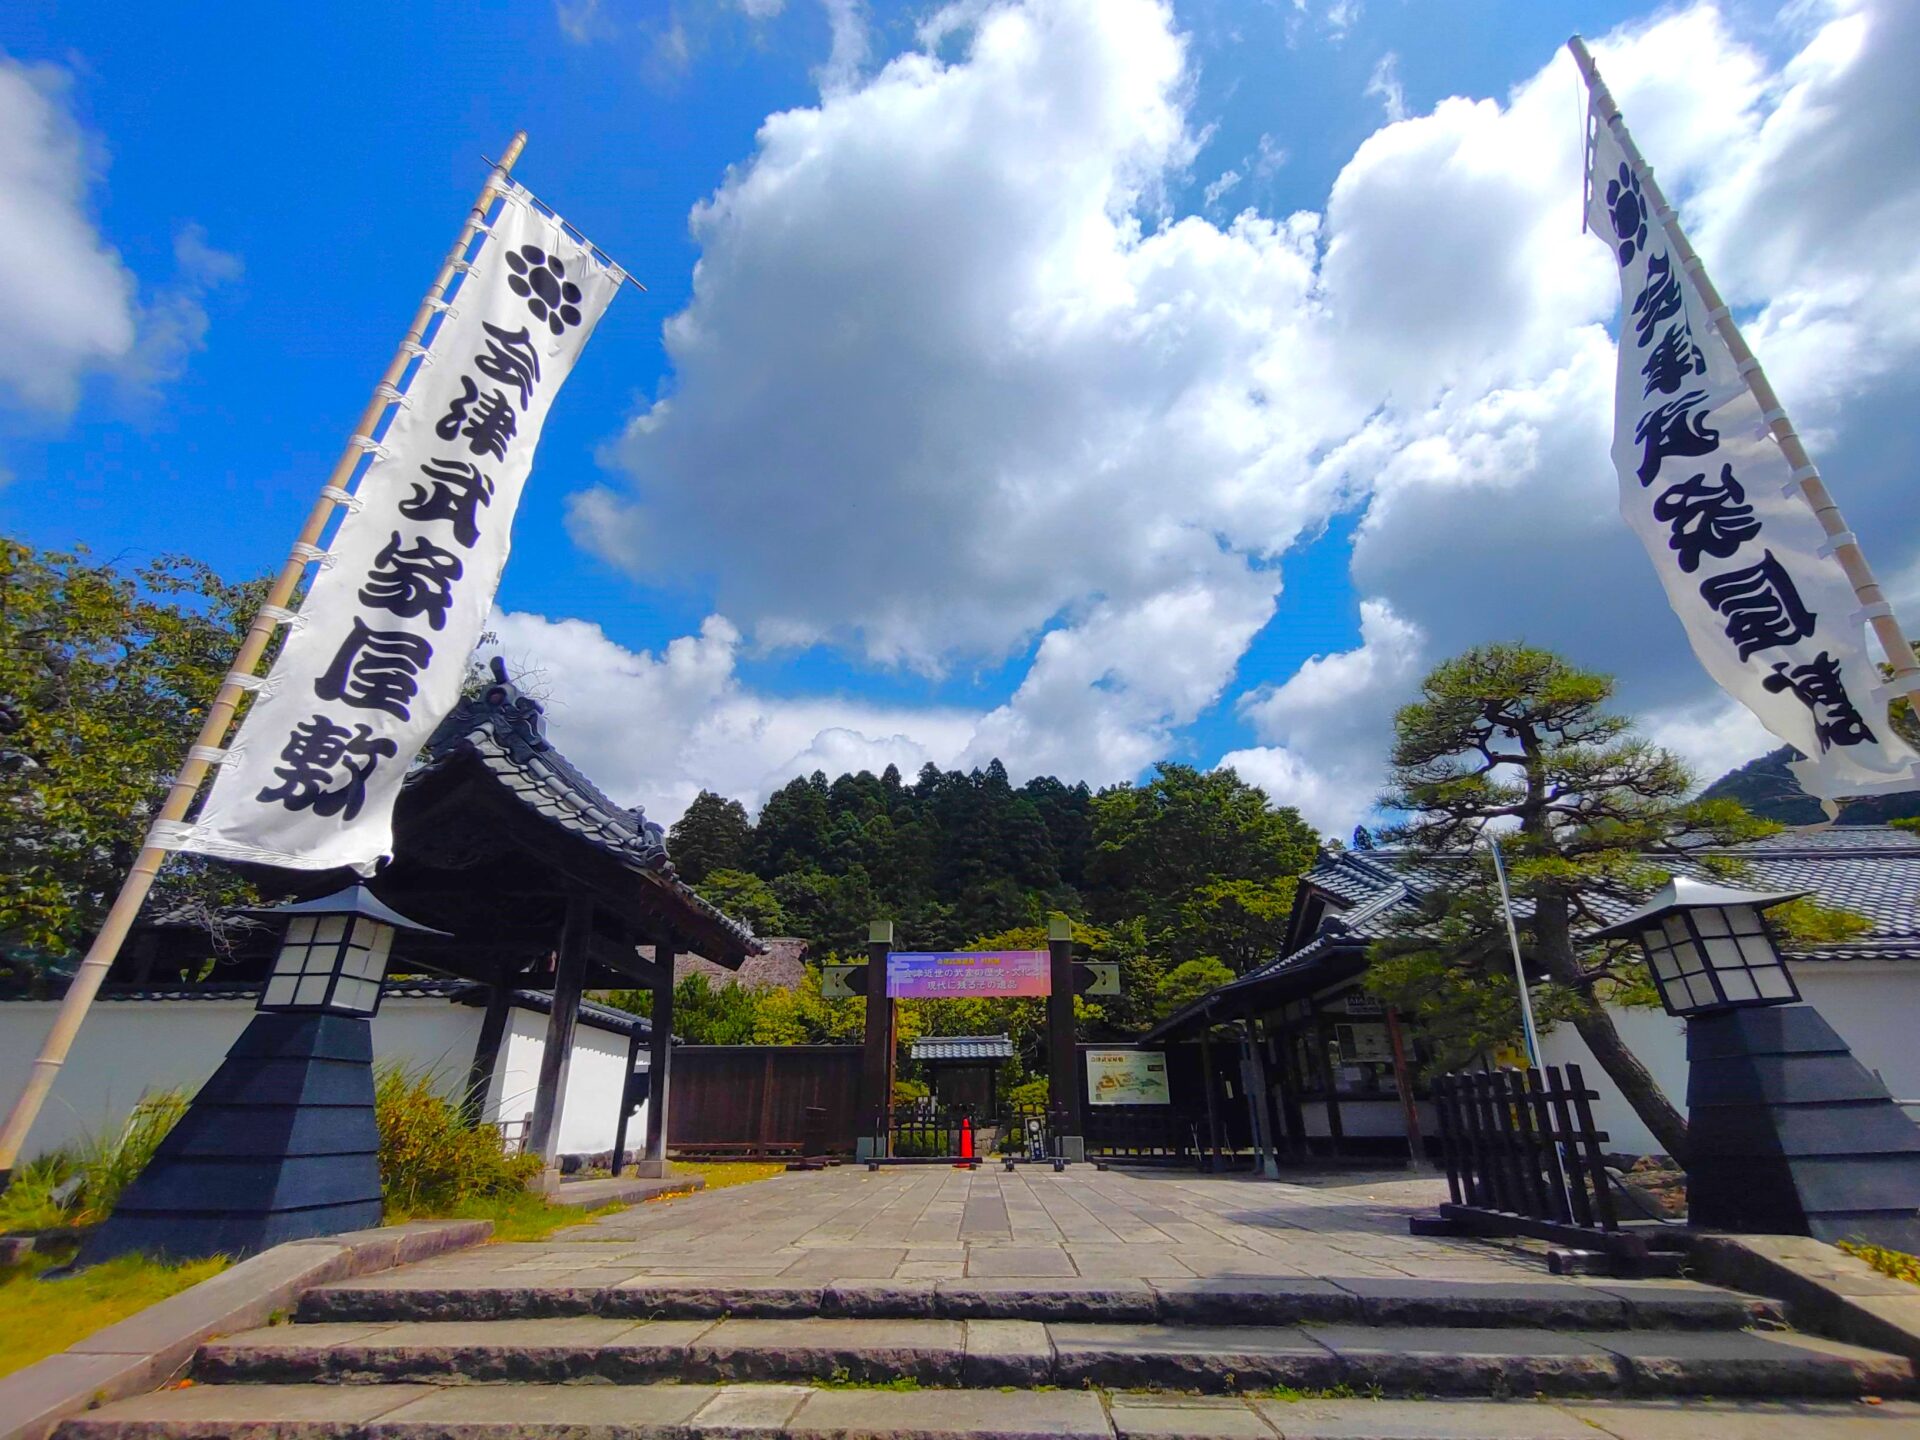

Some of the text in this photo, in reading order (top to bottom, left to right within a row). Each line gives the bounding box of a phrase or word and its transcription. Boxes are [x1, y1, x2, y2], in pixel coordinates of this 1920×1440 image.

[256, 320, 540, 821] 会津武家屋敷
